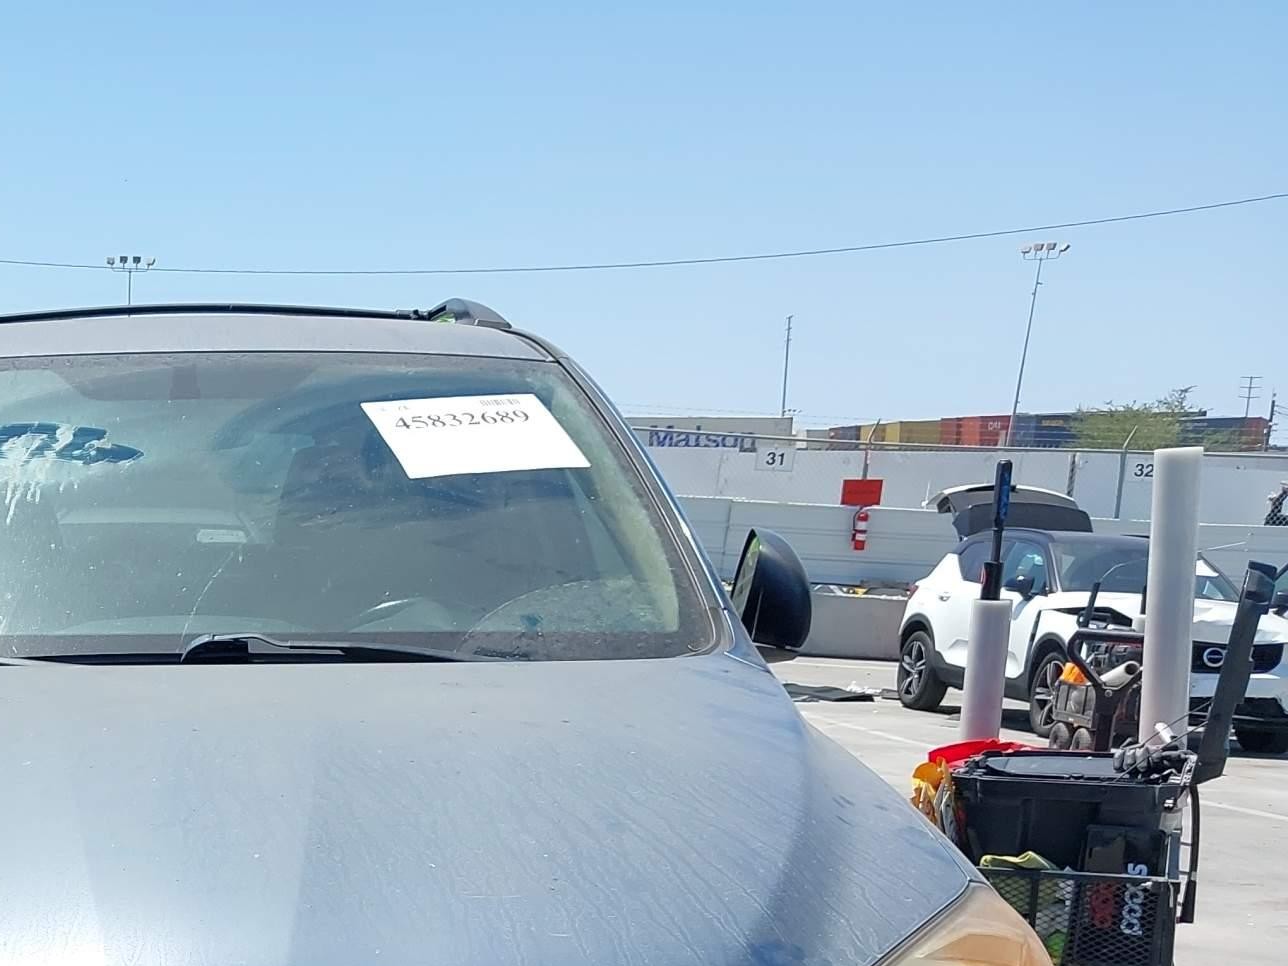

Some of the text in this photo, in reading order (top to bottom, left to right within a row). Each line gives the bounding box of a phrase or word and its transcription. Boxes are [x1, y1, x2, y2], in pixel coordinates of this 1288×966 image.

[395, 409, 530, 430] 45832689
[765, 452, 785, 466] 31
[1134, 463, 1154, 477] 32
